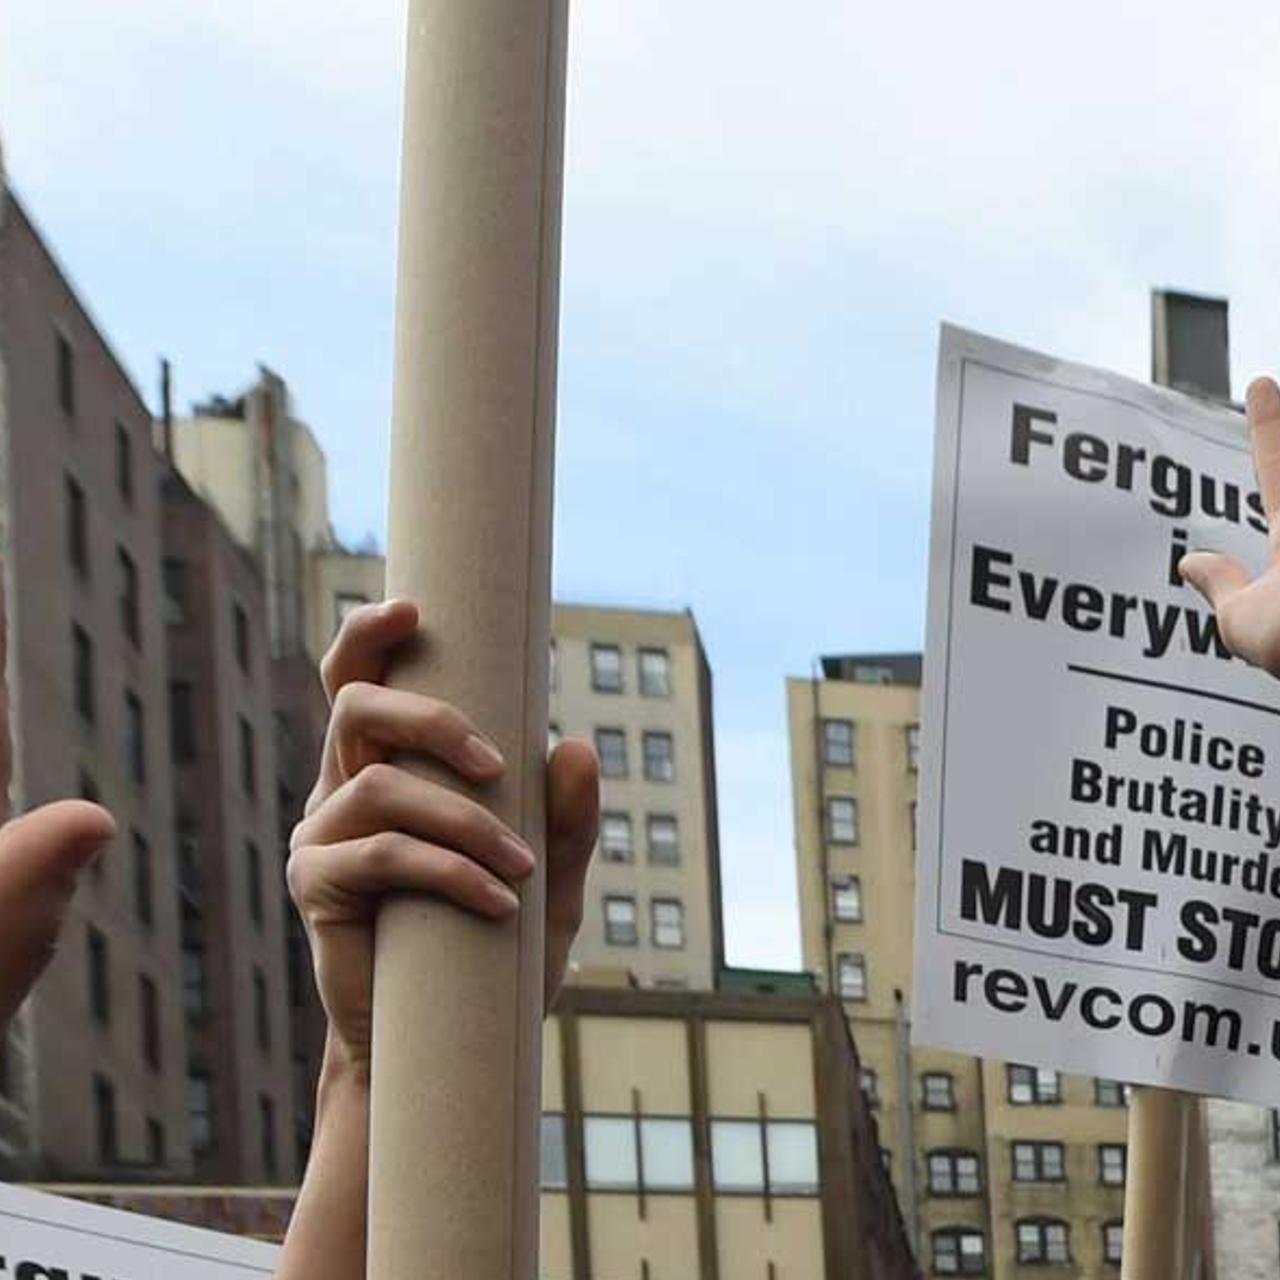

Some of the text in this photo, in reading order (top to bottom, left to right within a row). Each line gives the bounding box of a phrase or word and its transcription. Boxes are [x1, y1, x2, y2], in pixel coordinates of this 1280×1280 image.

[1104, 706, 1267, 779] Police
[1030, 815, 1122, 868] and
[958, 858, 1158, 954] MUST
